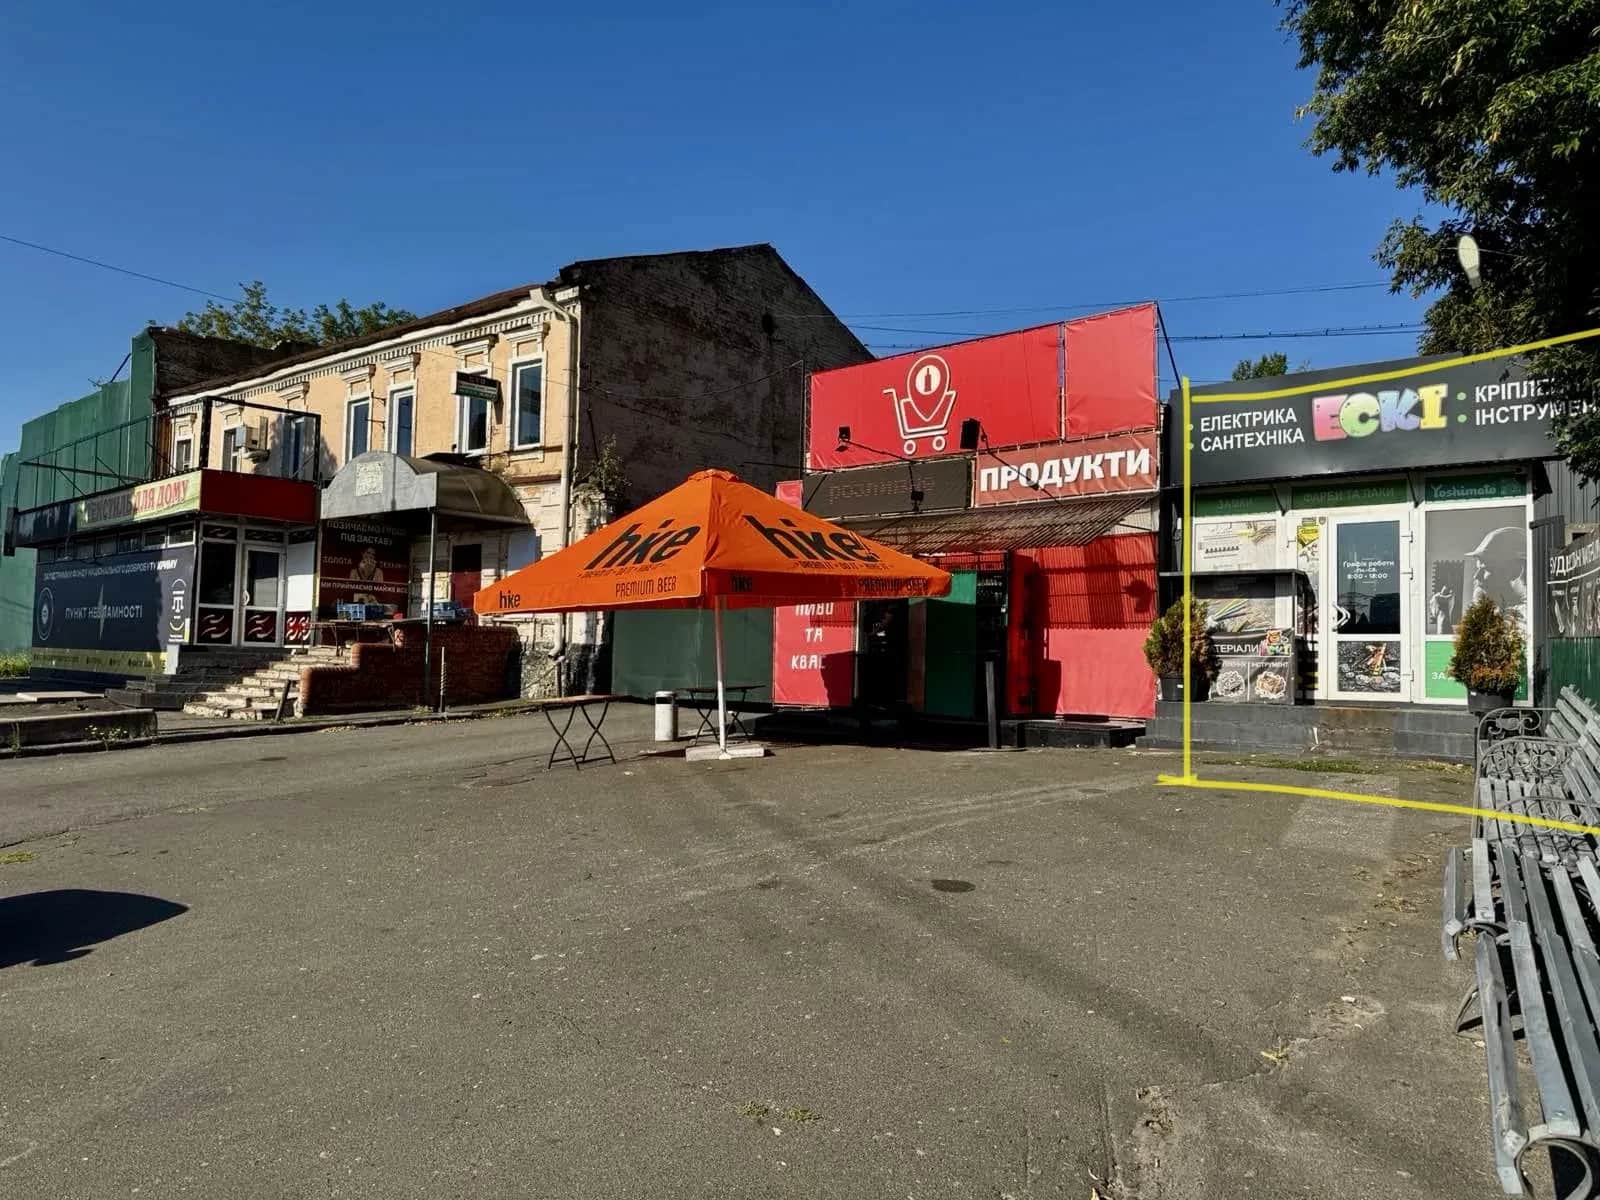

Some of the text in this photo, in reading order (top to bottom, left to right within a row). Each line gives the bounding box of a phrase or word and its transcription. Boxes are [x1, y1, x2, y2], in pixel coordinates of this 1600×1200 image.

[1200, 407, 1297, 432] ЕЛЕКТРИКА
[1475, 399, 1599, 427] ІНСТРУМЕН
[1200, 428, 1304, 453] САНТЕХНІКА
[979, 448, 1151, 493] ПРОДУКТИ
[156, 480, 189, 507] ДОМУ
[615, 575, 677, 598] PREMIUM BEER
[499, 590, 521, 609] hike
[65, 607, 87, 619] ПУНКТ
[804, 628, 823, 643] ТА
[1213, 643, 1259, 654] ТЕРІАЛИ
